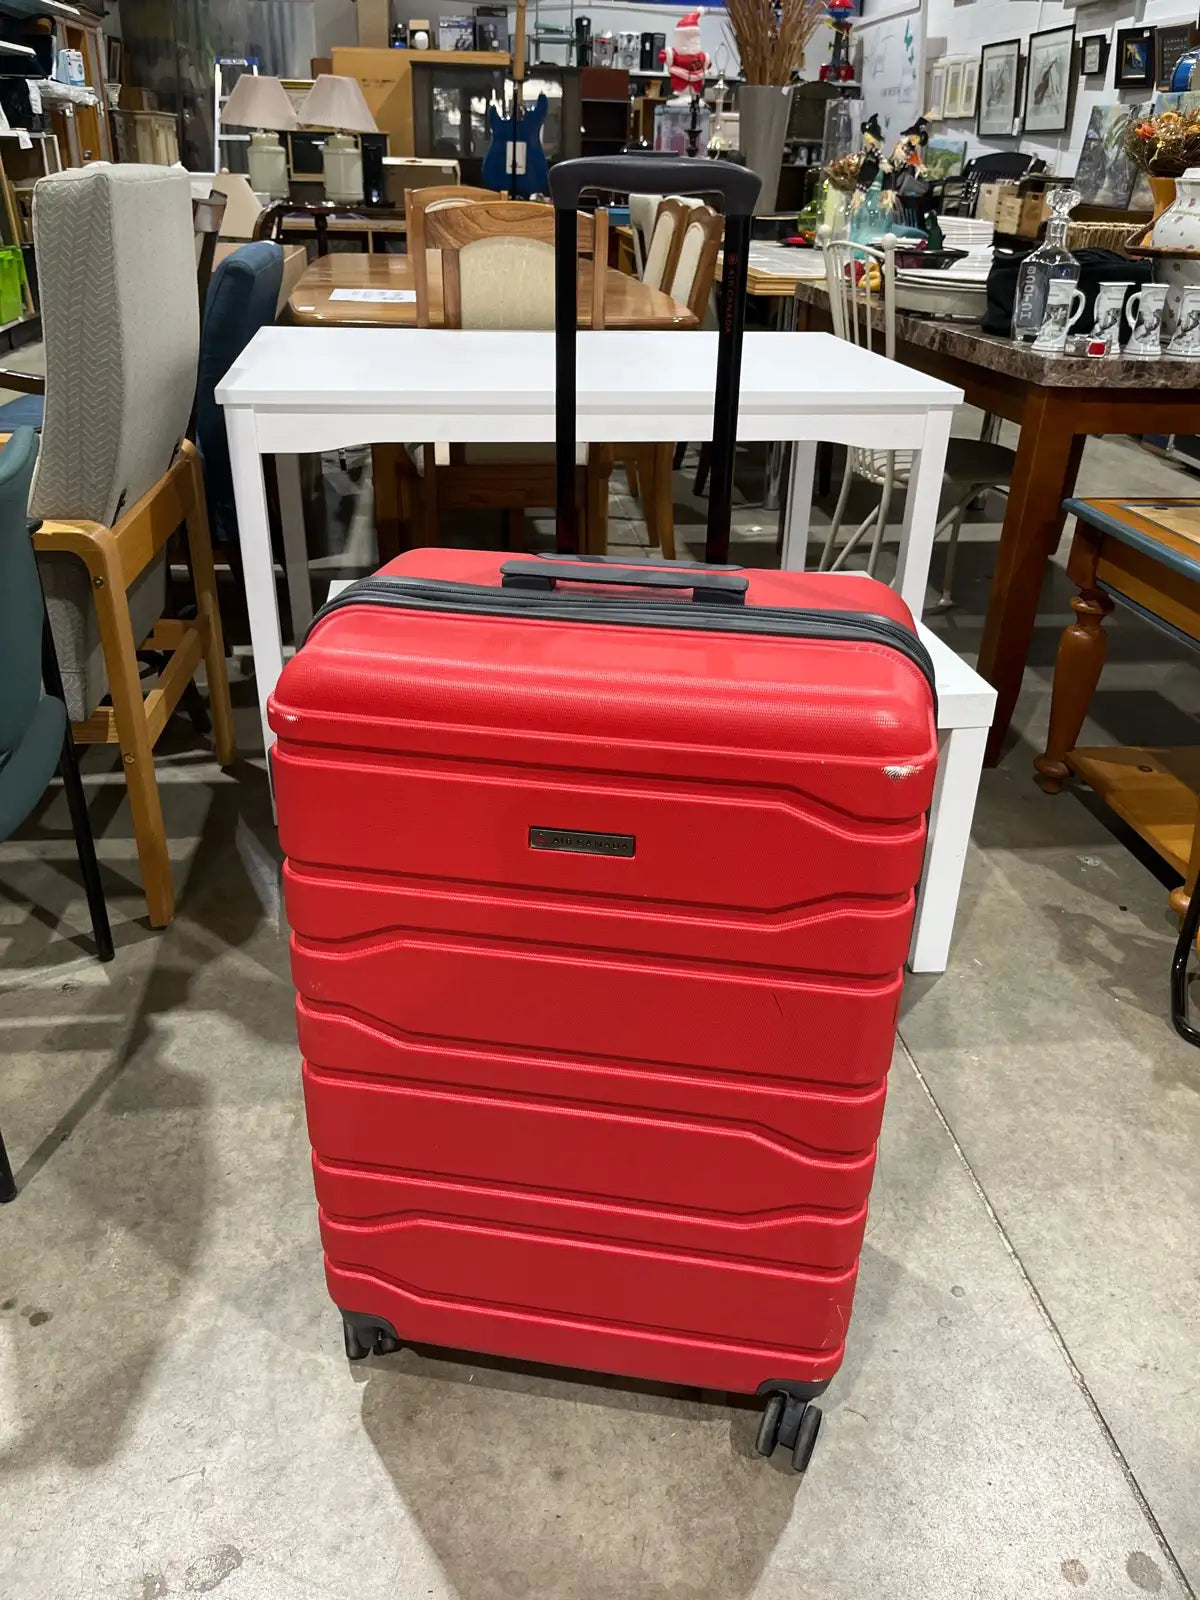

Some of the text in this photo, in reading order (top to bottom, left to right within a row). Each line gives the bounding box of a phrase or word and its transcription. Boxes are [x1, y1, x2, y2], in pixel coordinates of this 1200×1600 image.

[725, 269, 736, 334] AIR CANADA
[1019, 265, 1036, 320] SCOTCH
[552, 837, 629, 850] AIR CANADA
